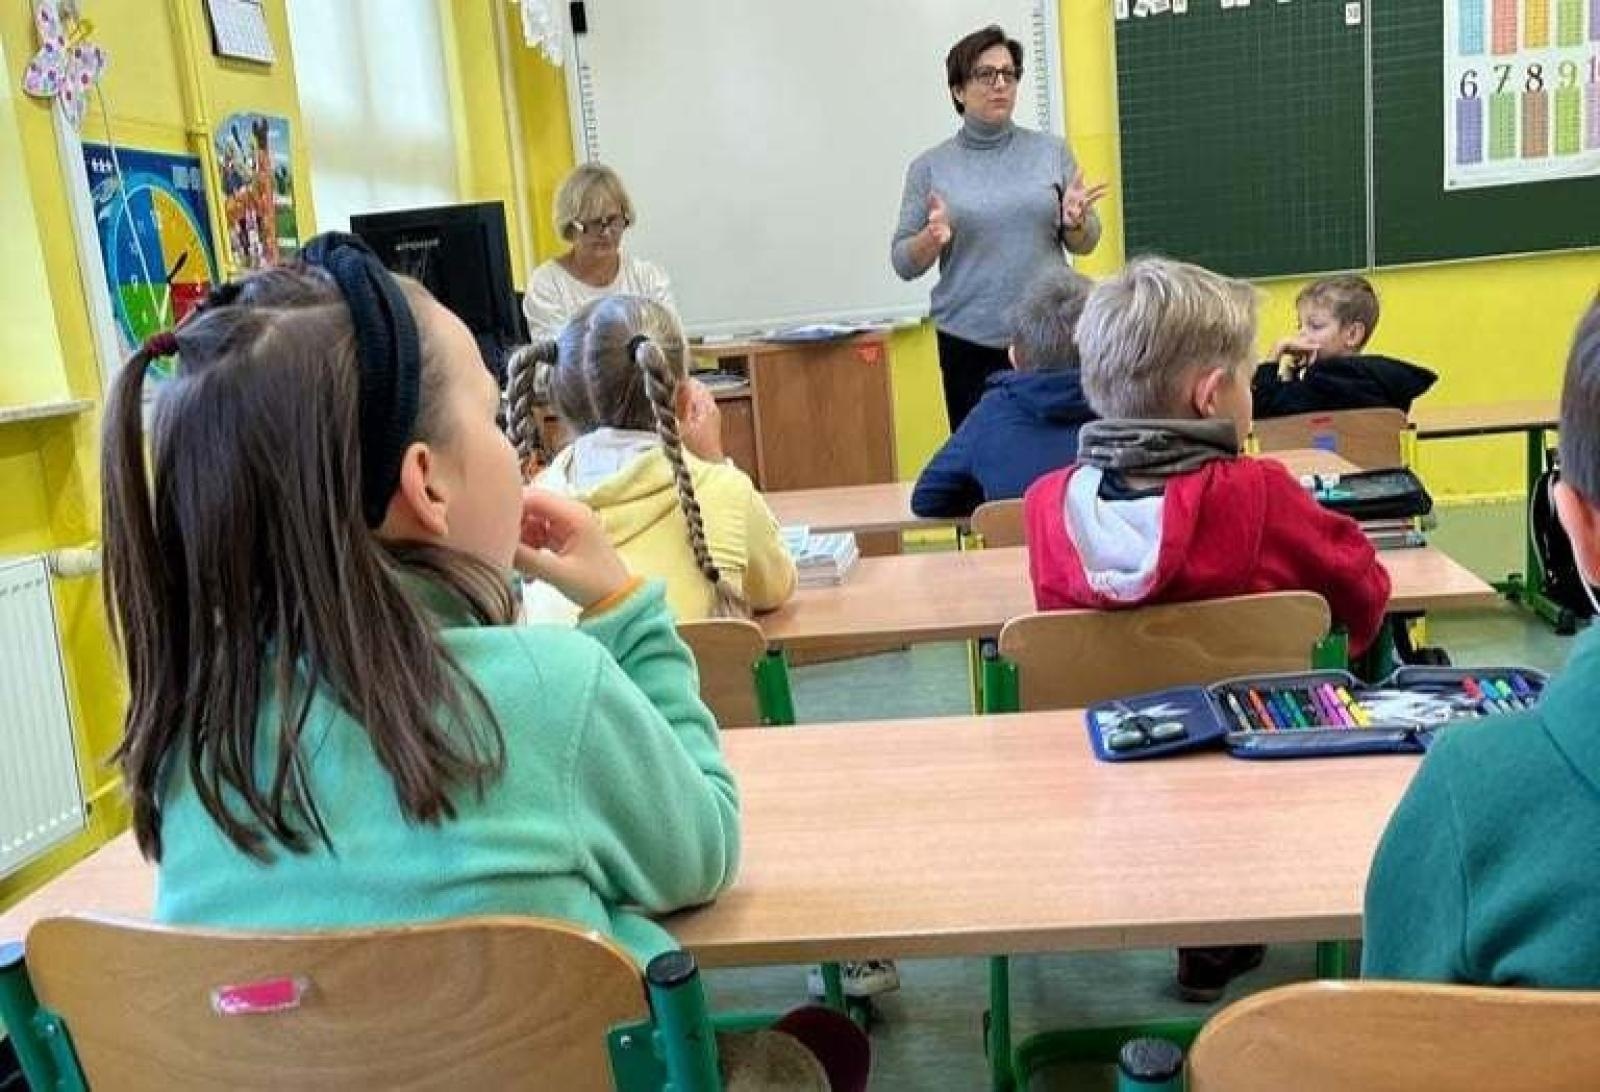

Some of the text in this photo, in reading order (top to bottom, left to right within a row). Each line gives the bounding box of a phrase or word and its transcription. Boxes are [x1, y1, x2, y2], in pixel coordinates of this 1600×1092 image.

[1460, 54, 1600, 99] 6 7 8 9 1
